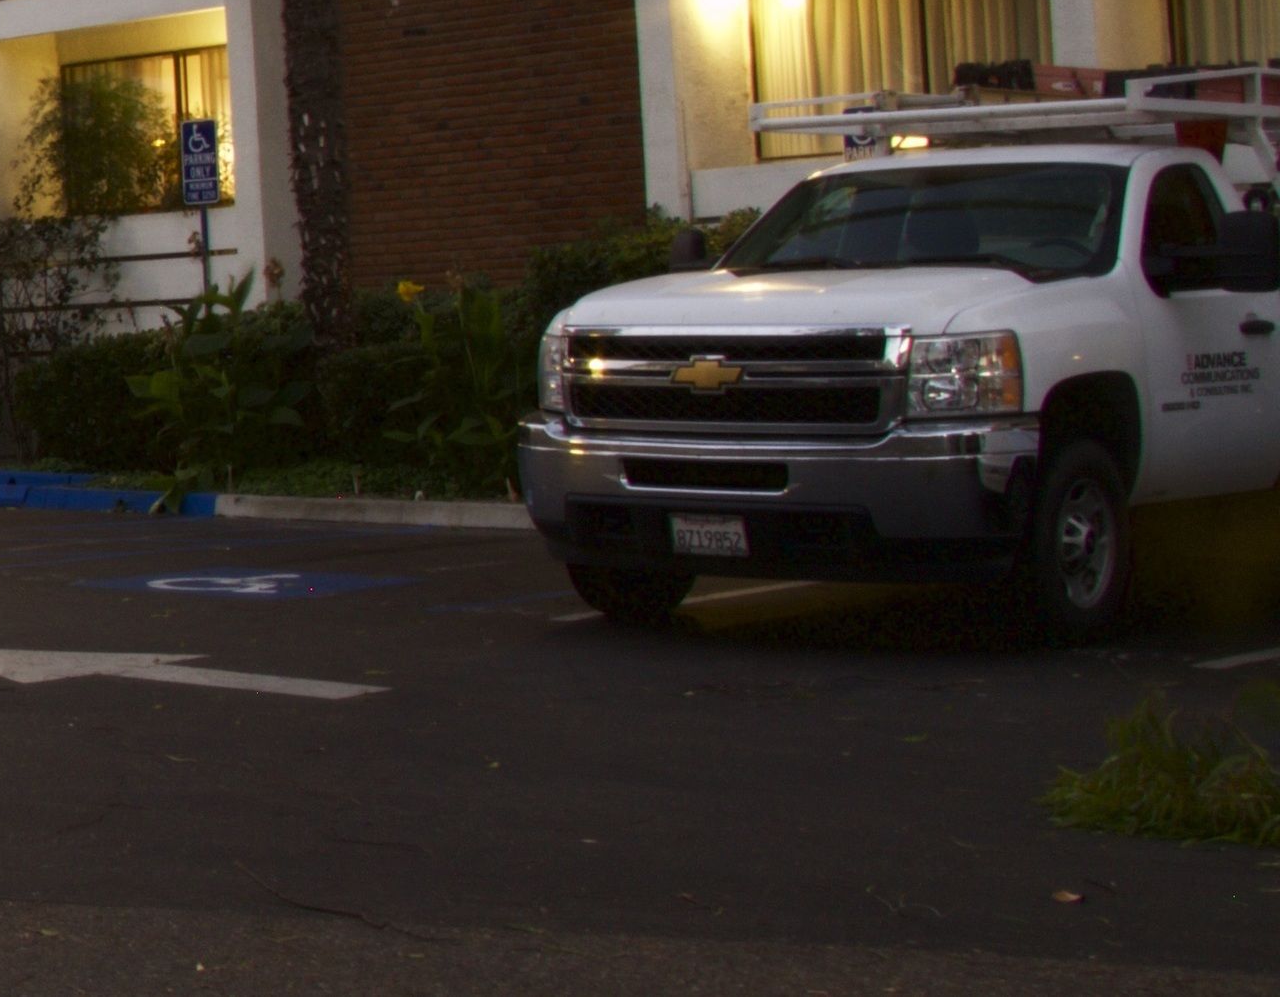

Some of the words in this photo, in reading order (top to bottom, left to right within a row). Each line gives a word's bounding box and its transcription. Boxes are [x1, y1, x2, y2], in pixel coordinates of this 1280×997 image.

[183, 151, 215, 166] PARKING
[189, 166, 211, 179] ONLY
[188, 181, 213, 191] MINIMUM
[1194, 351, 1247, 369] ADVANCE
[1180, 367, 1260, 385] COMMUNICATIONS
[1197, 385, 1239, 397] CONSULTING
